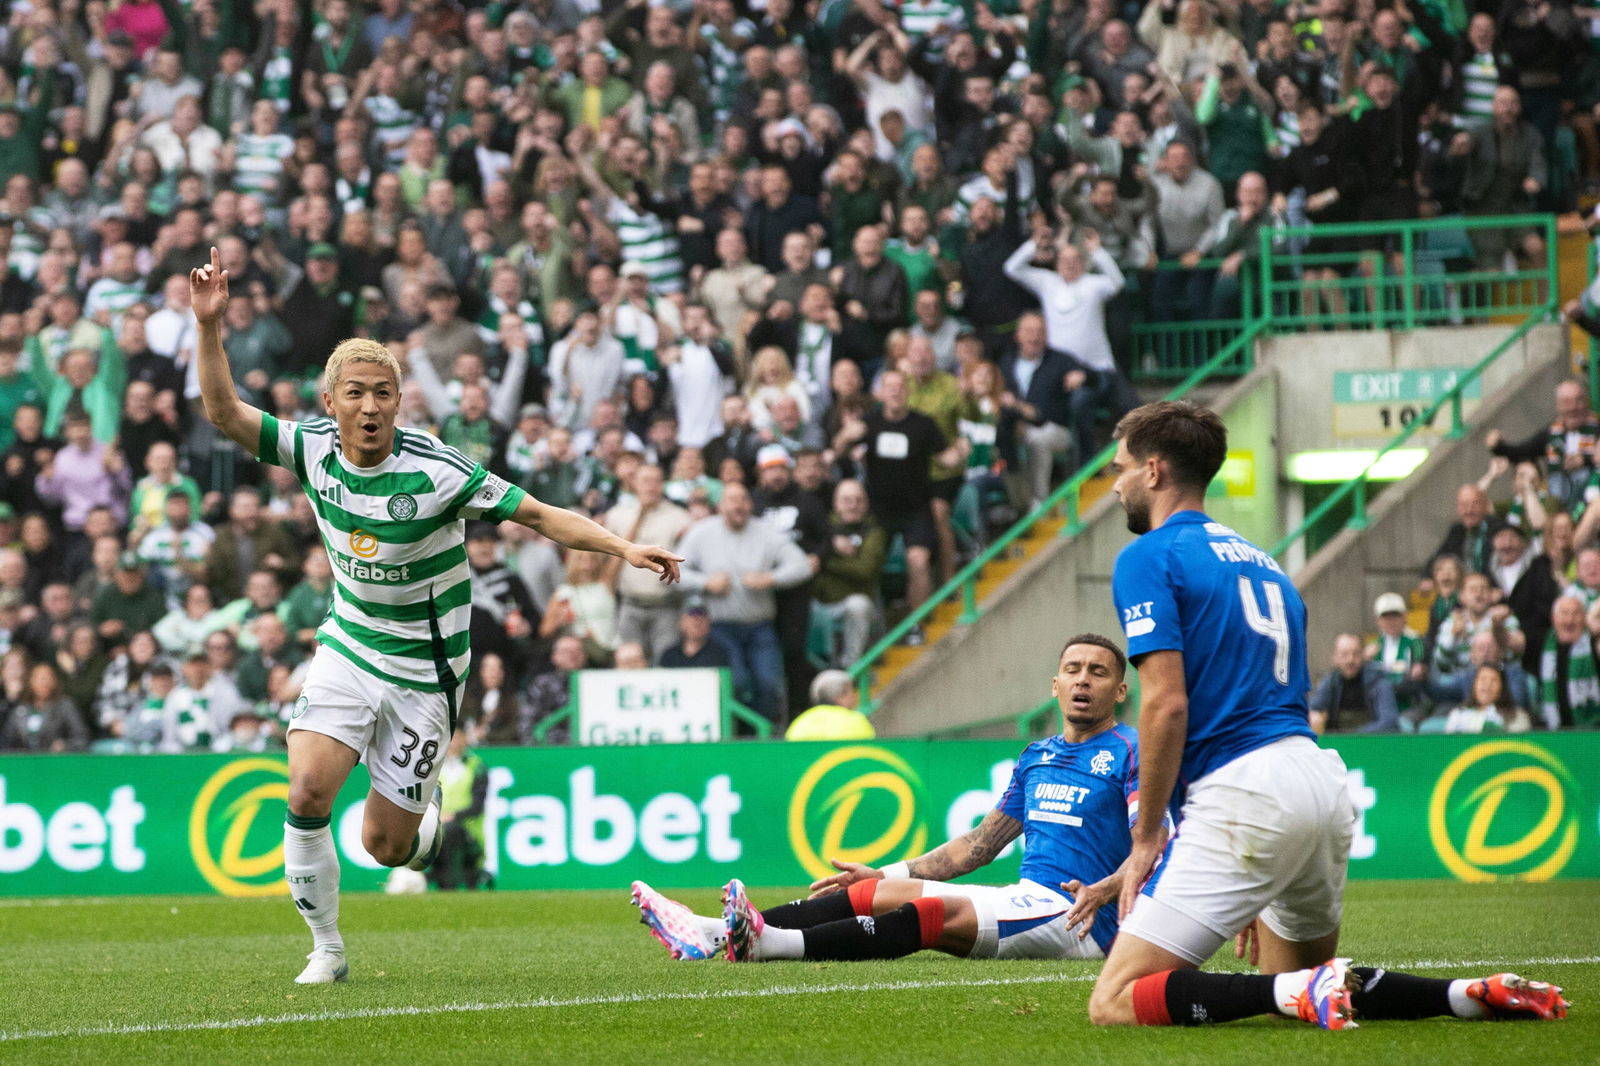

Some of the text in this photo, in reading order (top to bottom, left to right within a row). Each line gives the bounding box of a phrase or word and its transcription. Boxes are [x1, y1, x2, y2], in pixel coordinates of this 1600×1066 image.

[1351, 373, 1402, 401] EXIT
[331, 550, 410, 581] dafabet
[1238, 574, 1290, 687] 4
[616, 683, 681, 711] Exit
[589, 723, 713, 744] Gate 11
[391, 726, 439, 780] 38
[1034, 783, 1091, 805] UNIBET
